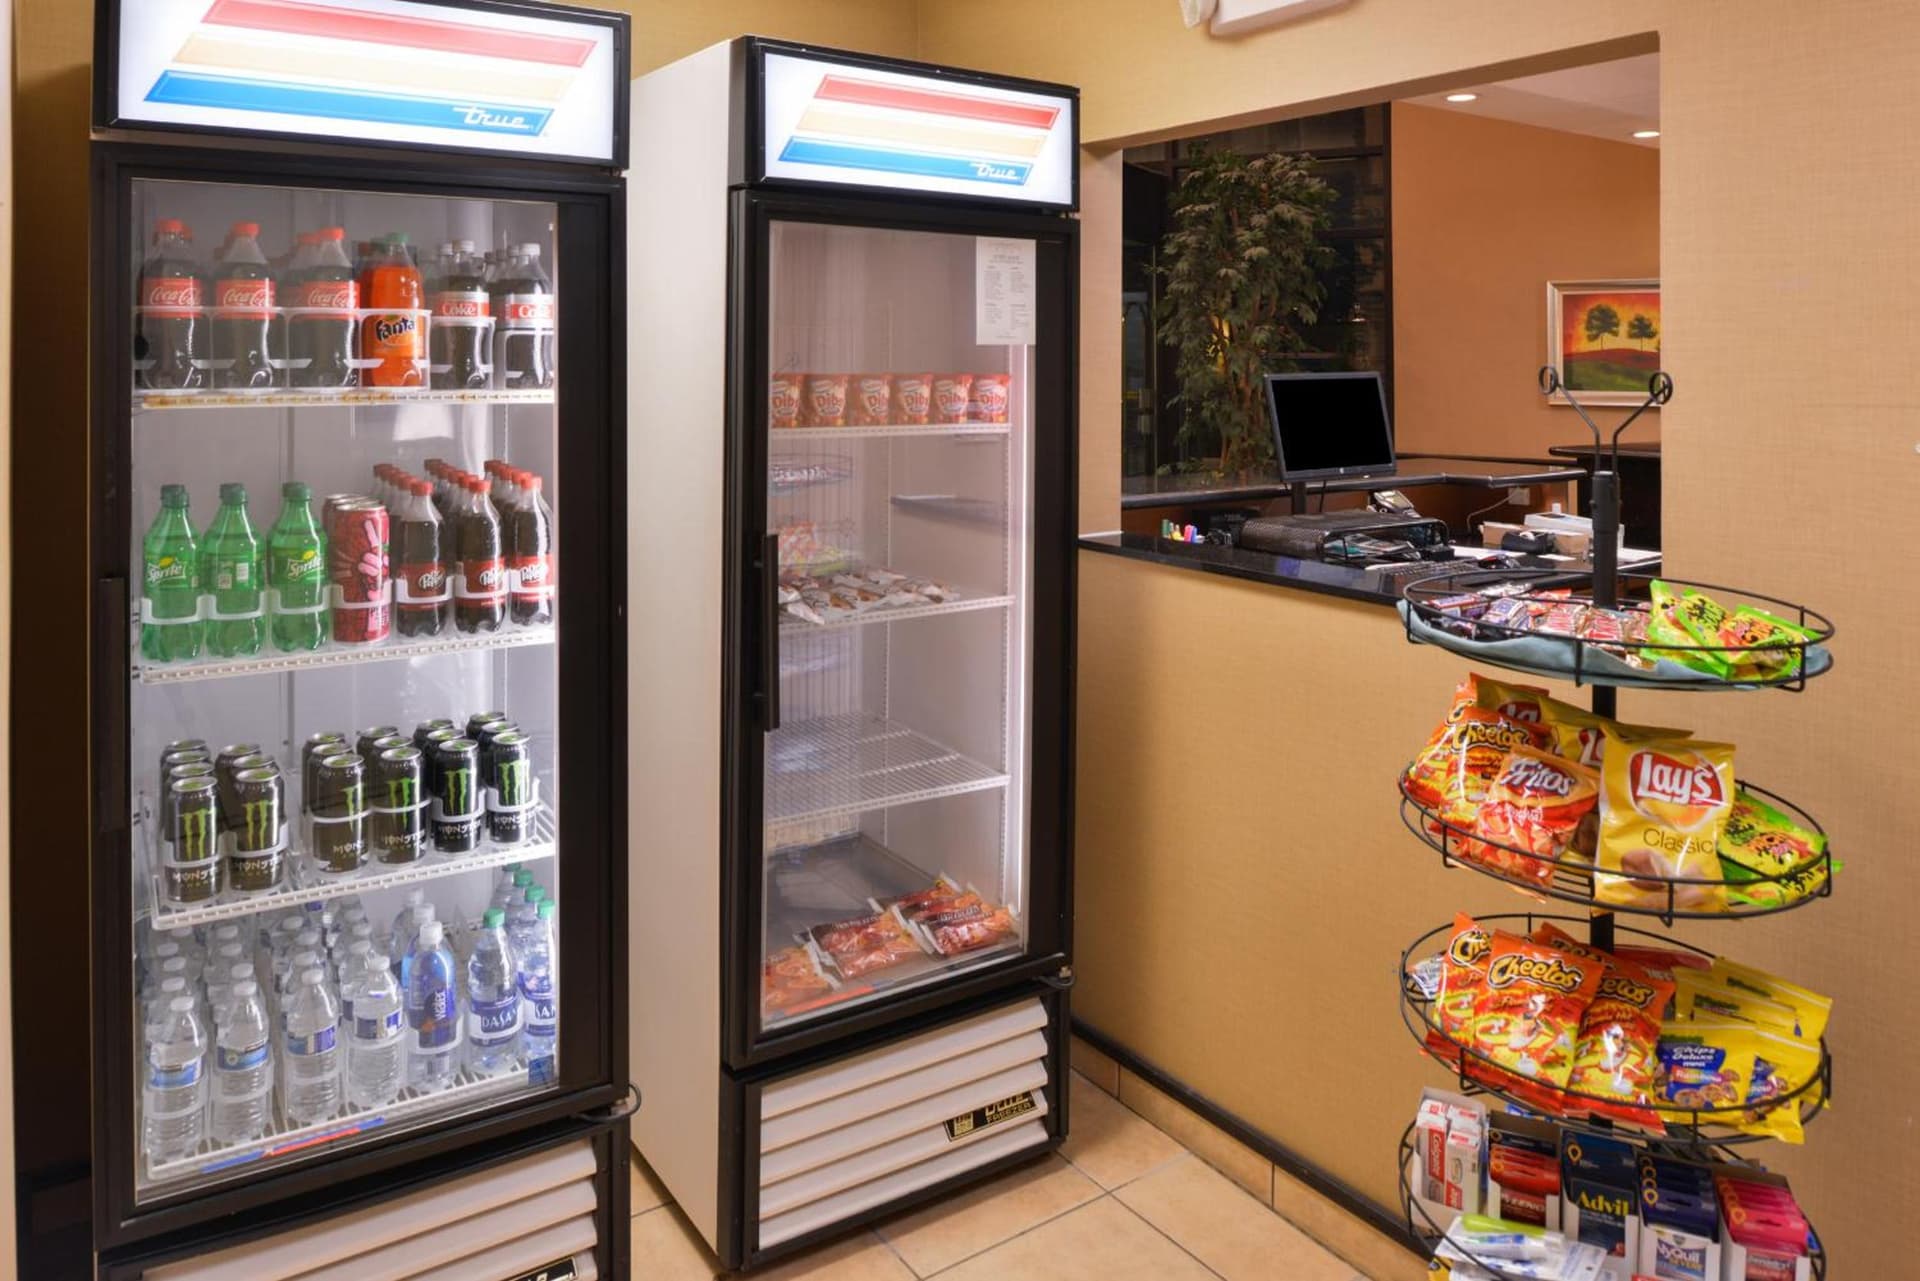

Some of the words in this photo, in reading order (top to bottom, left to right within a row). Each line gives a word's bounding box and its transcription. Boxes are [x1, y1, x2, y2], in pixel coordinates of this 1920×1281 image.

[442, 302, 477, 316] Coke
[148, 562, 184, 581] Sprite
[1452, 722, 1528, 750] Cheetos
[1500, 759, 1576, 796] Fritos
[1643, 828, 1715, 855] Classic
[1490, 955, 1577, 987] Cheetos
[1602, 978, 1652, 1004] etos
[1578, 1190, 1630, 1217] Advil
